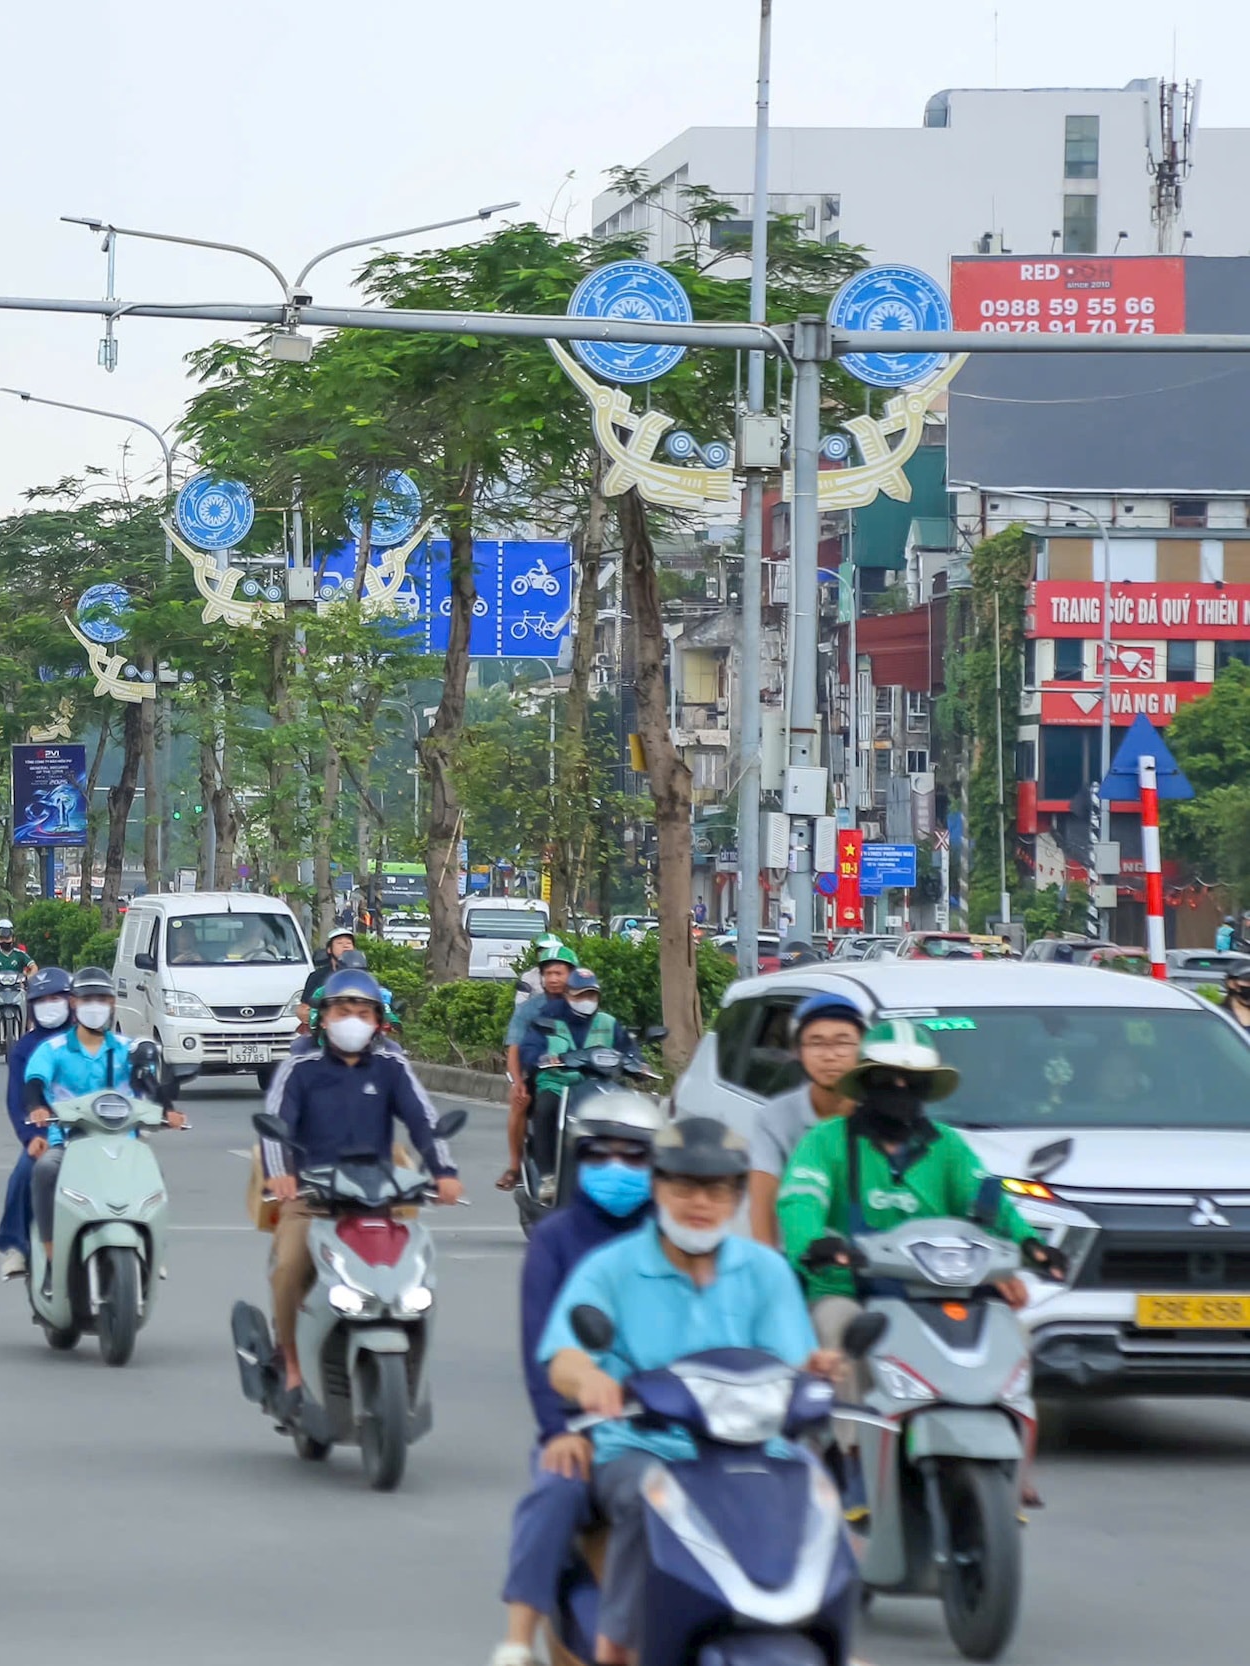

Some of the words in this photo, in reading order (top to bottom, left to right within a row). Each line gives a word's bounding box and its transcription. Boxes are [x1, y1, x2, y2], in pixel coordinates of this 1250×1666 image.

[1020, 264, 1060, 280] RED
[980, 299, 1040, 317] 0988
[1049, 298, 1078, 316] 59
[1086, 298, 1117, 315] 55
[1124, 297, 1155, 315] 66
[980, 320, 1040, 333] 0978
[1048, 319, 1077, 333] 91
[1086, 319, 1117, 334] 70
[1125, 318, 1155, 334] 75
[1050, 597, 1100, 624] TRANG
[1138, 593, 1158, 624] ĐÁ
[1161, 594, 1191, 627] QUÝ
[1111, 689, 1160, 714] VÀNG
